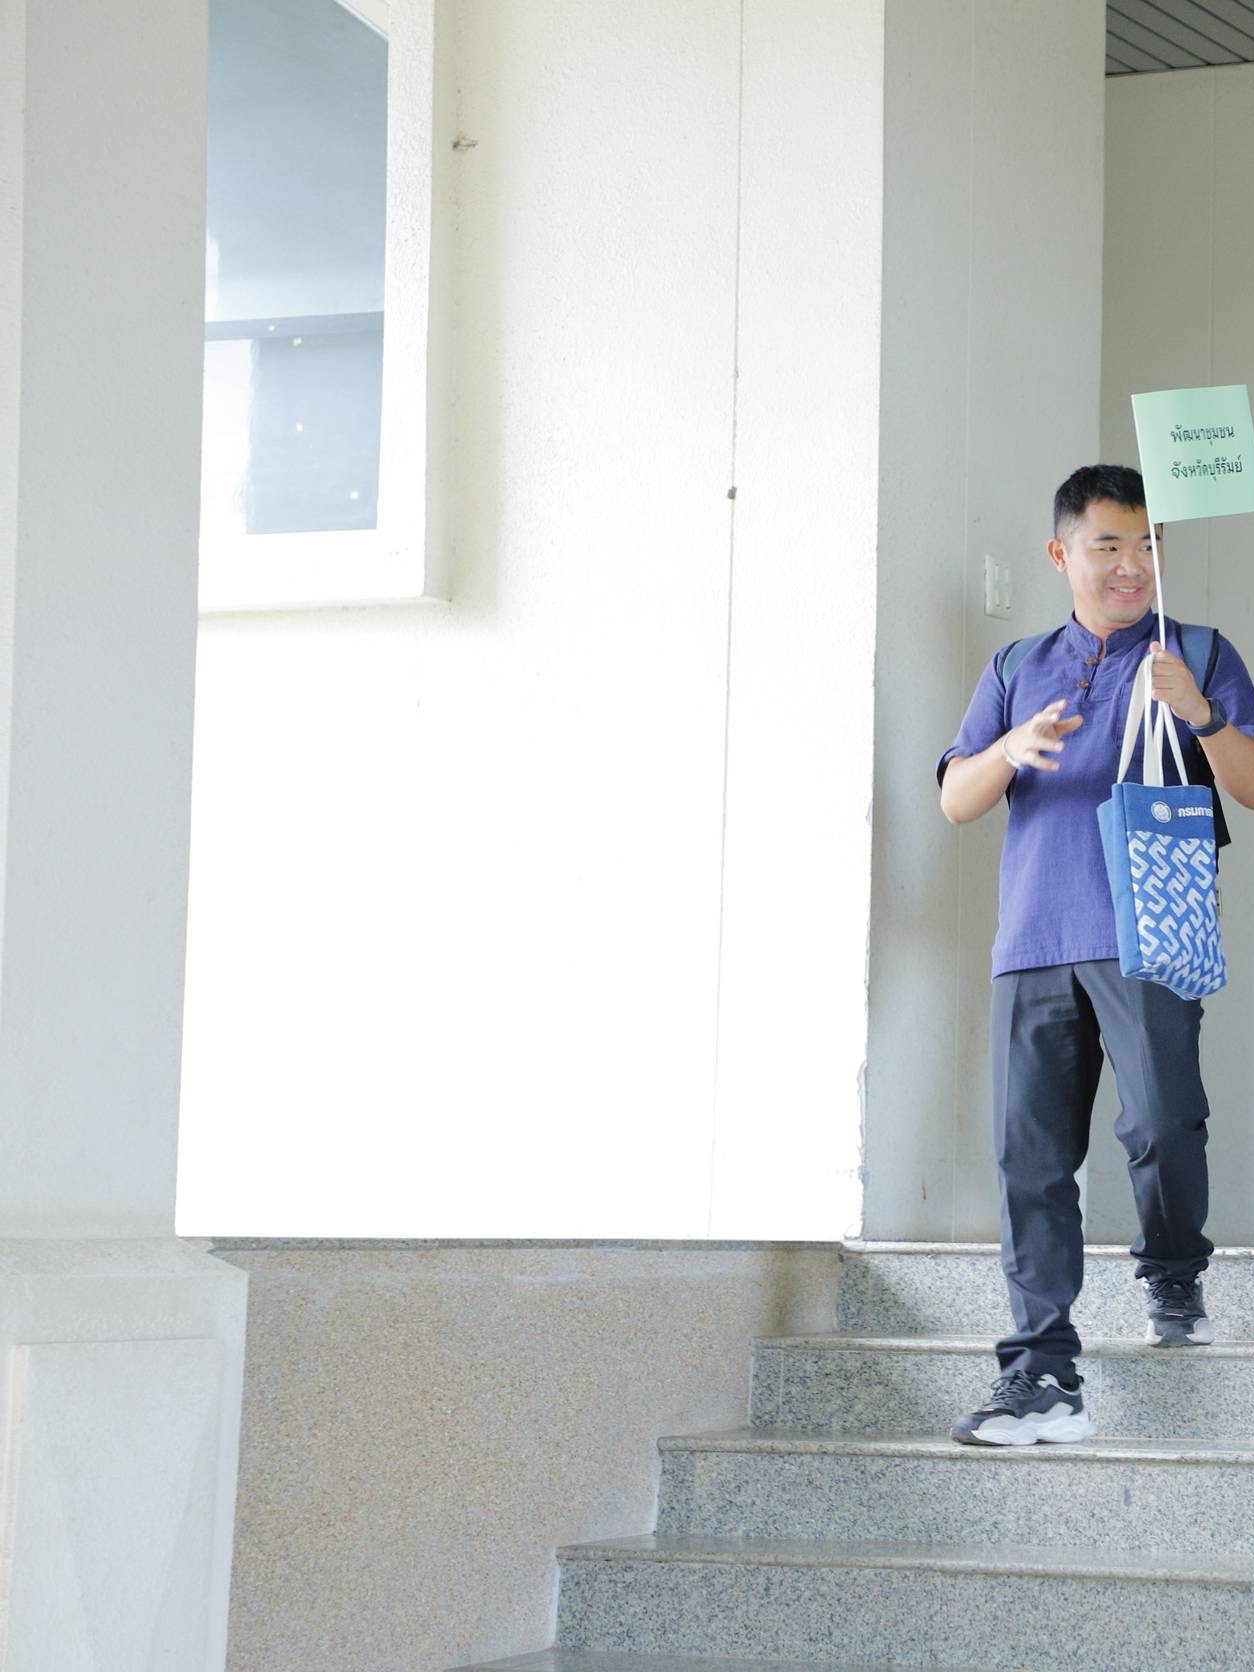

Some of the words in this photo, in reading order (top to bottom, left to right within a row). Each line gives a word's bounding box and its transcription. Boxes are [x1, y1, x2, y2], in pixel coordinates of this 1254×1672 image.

[1170, 424, 1235, 446] พัฒนาชุมชน
[1171, 455, 1243, 481] จังหวัดบุรีรัมย์
